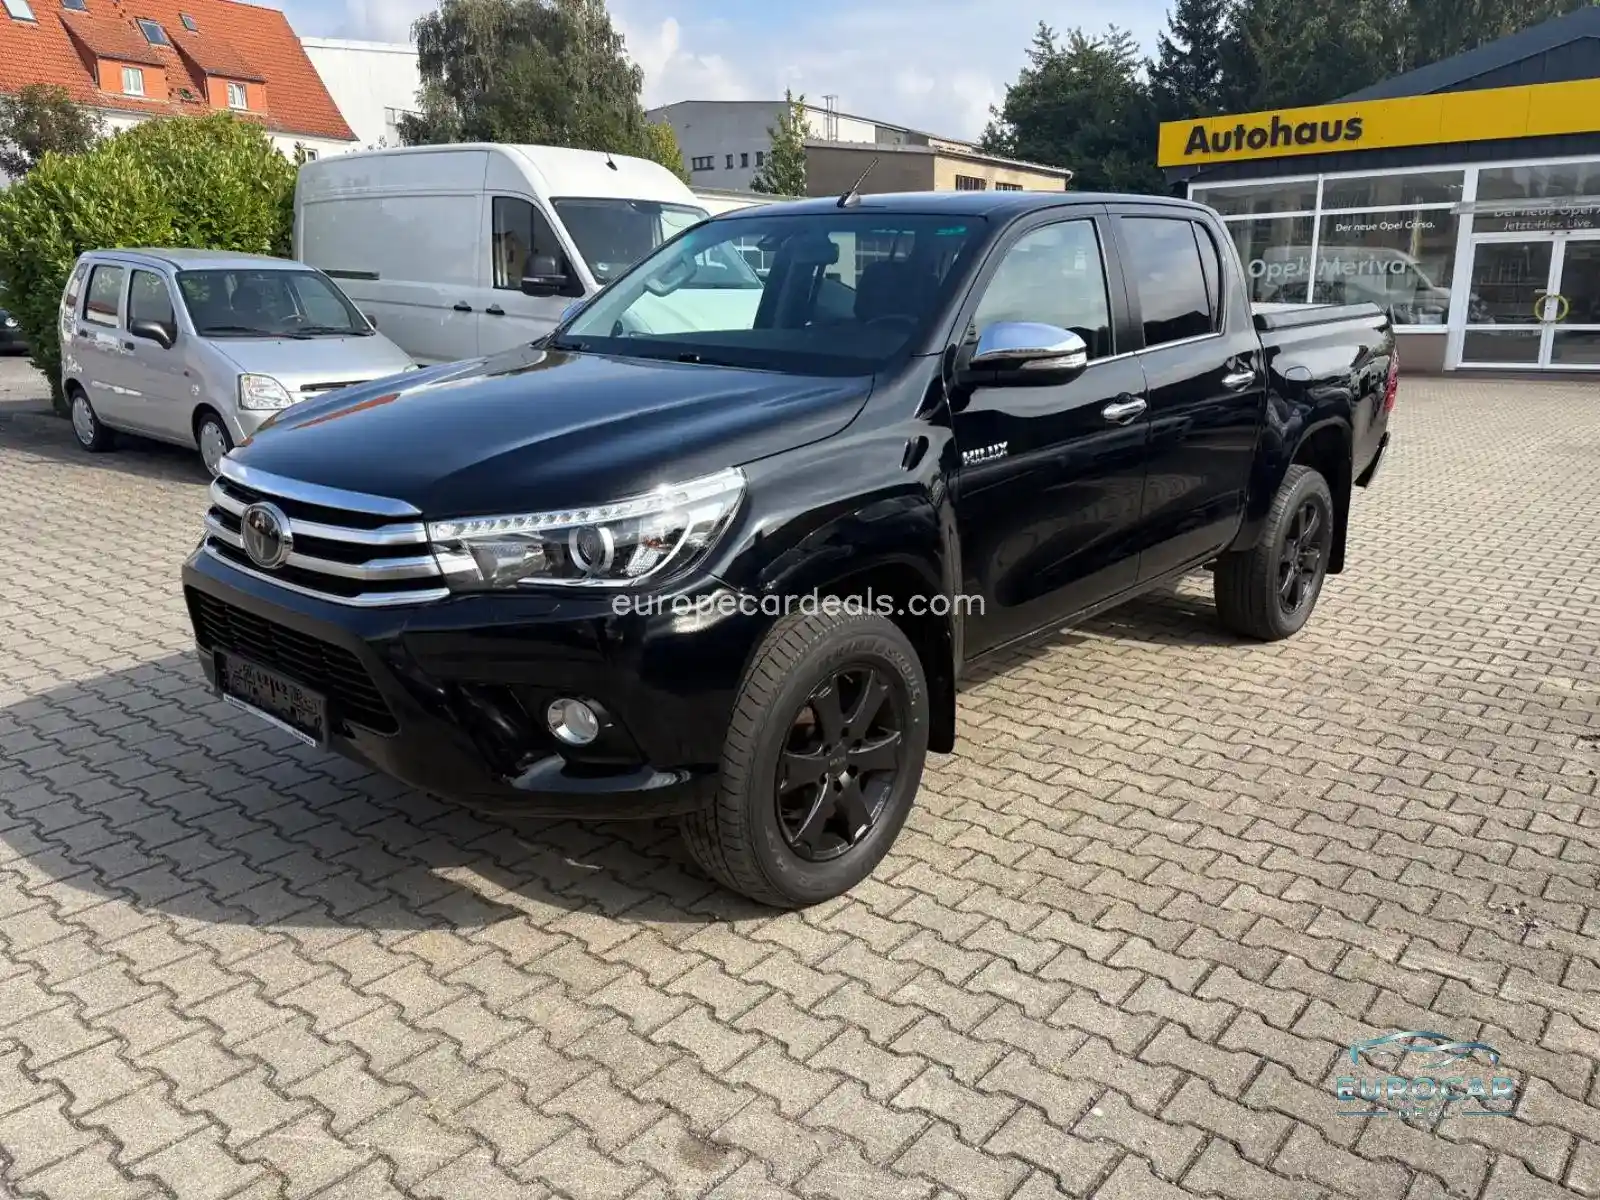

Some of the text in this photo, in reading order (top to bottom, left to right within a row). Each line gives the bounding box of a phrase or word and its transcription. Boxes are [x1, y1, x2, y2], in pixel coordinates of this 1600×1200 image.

[1184, 115, 1363, 155] Autohaus
[1335, 222, 1351, 232] Der
[1354, 223, 1377, 231] neue
[1379, 220, 1403, 231] Opel
[1248, 255, 1407, 288] Opel Meriva
